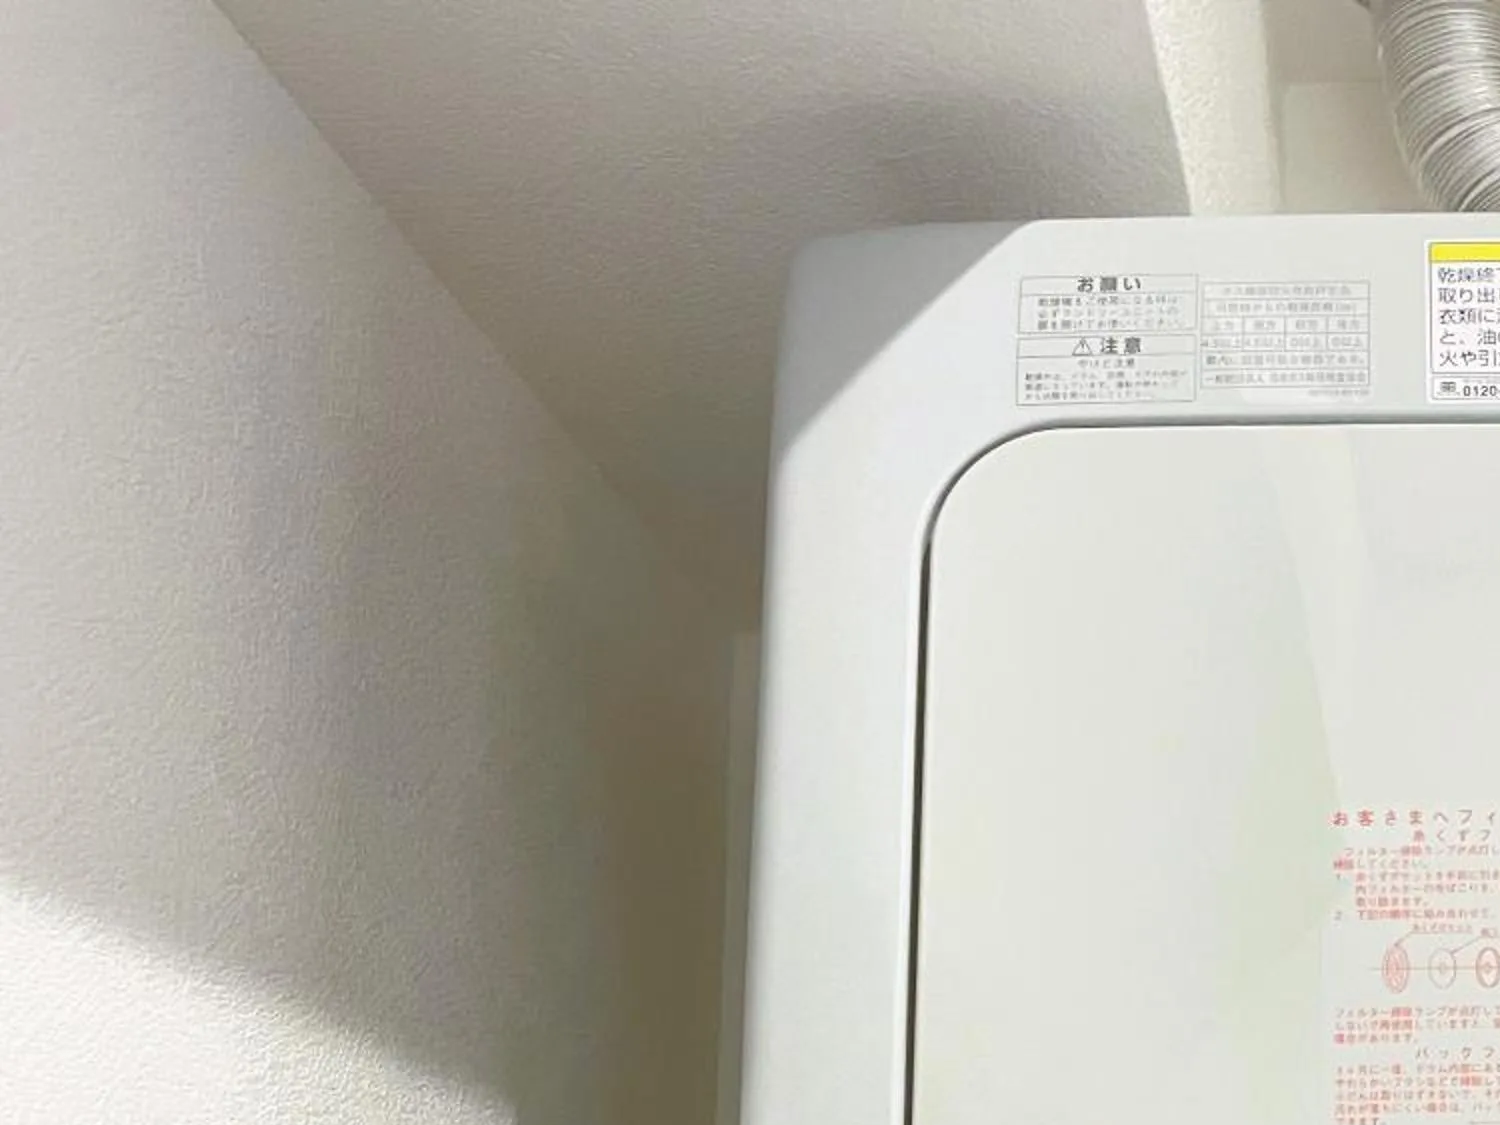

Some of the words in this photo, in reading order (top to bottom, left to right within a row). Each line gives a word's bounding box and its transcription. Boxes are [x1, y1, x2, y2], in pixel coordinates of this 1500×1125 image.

[1077, 277, 1141, 292] お願い
[1100, 337, 1141, 354] 注意
